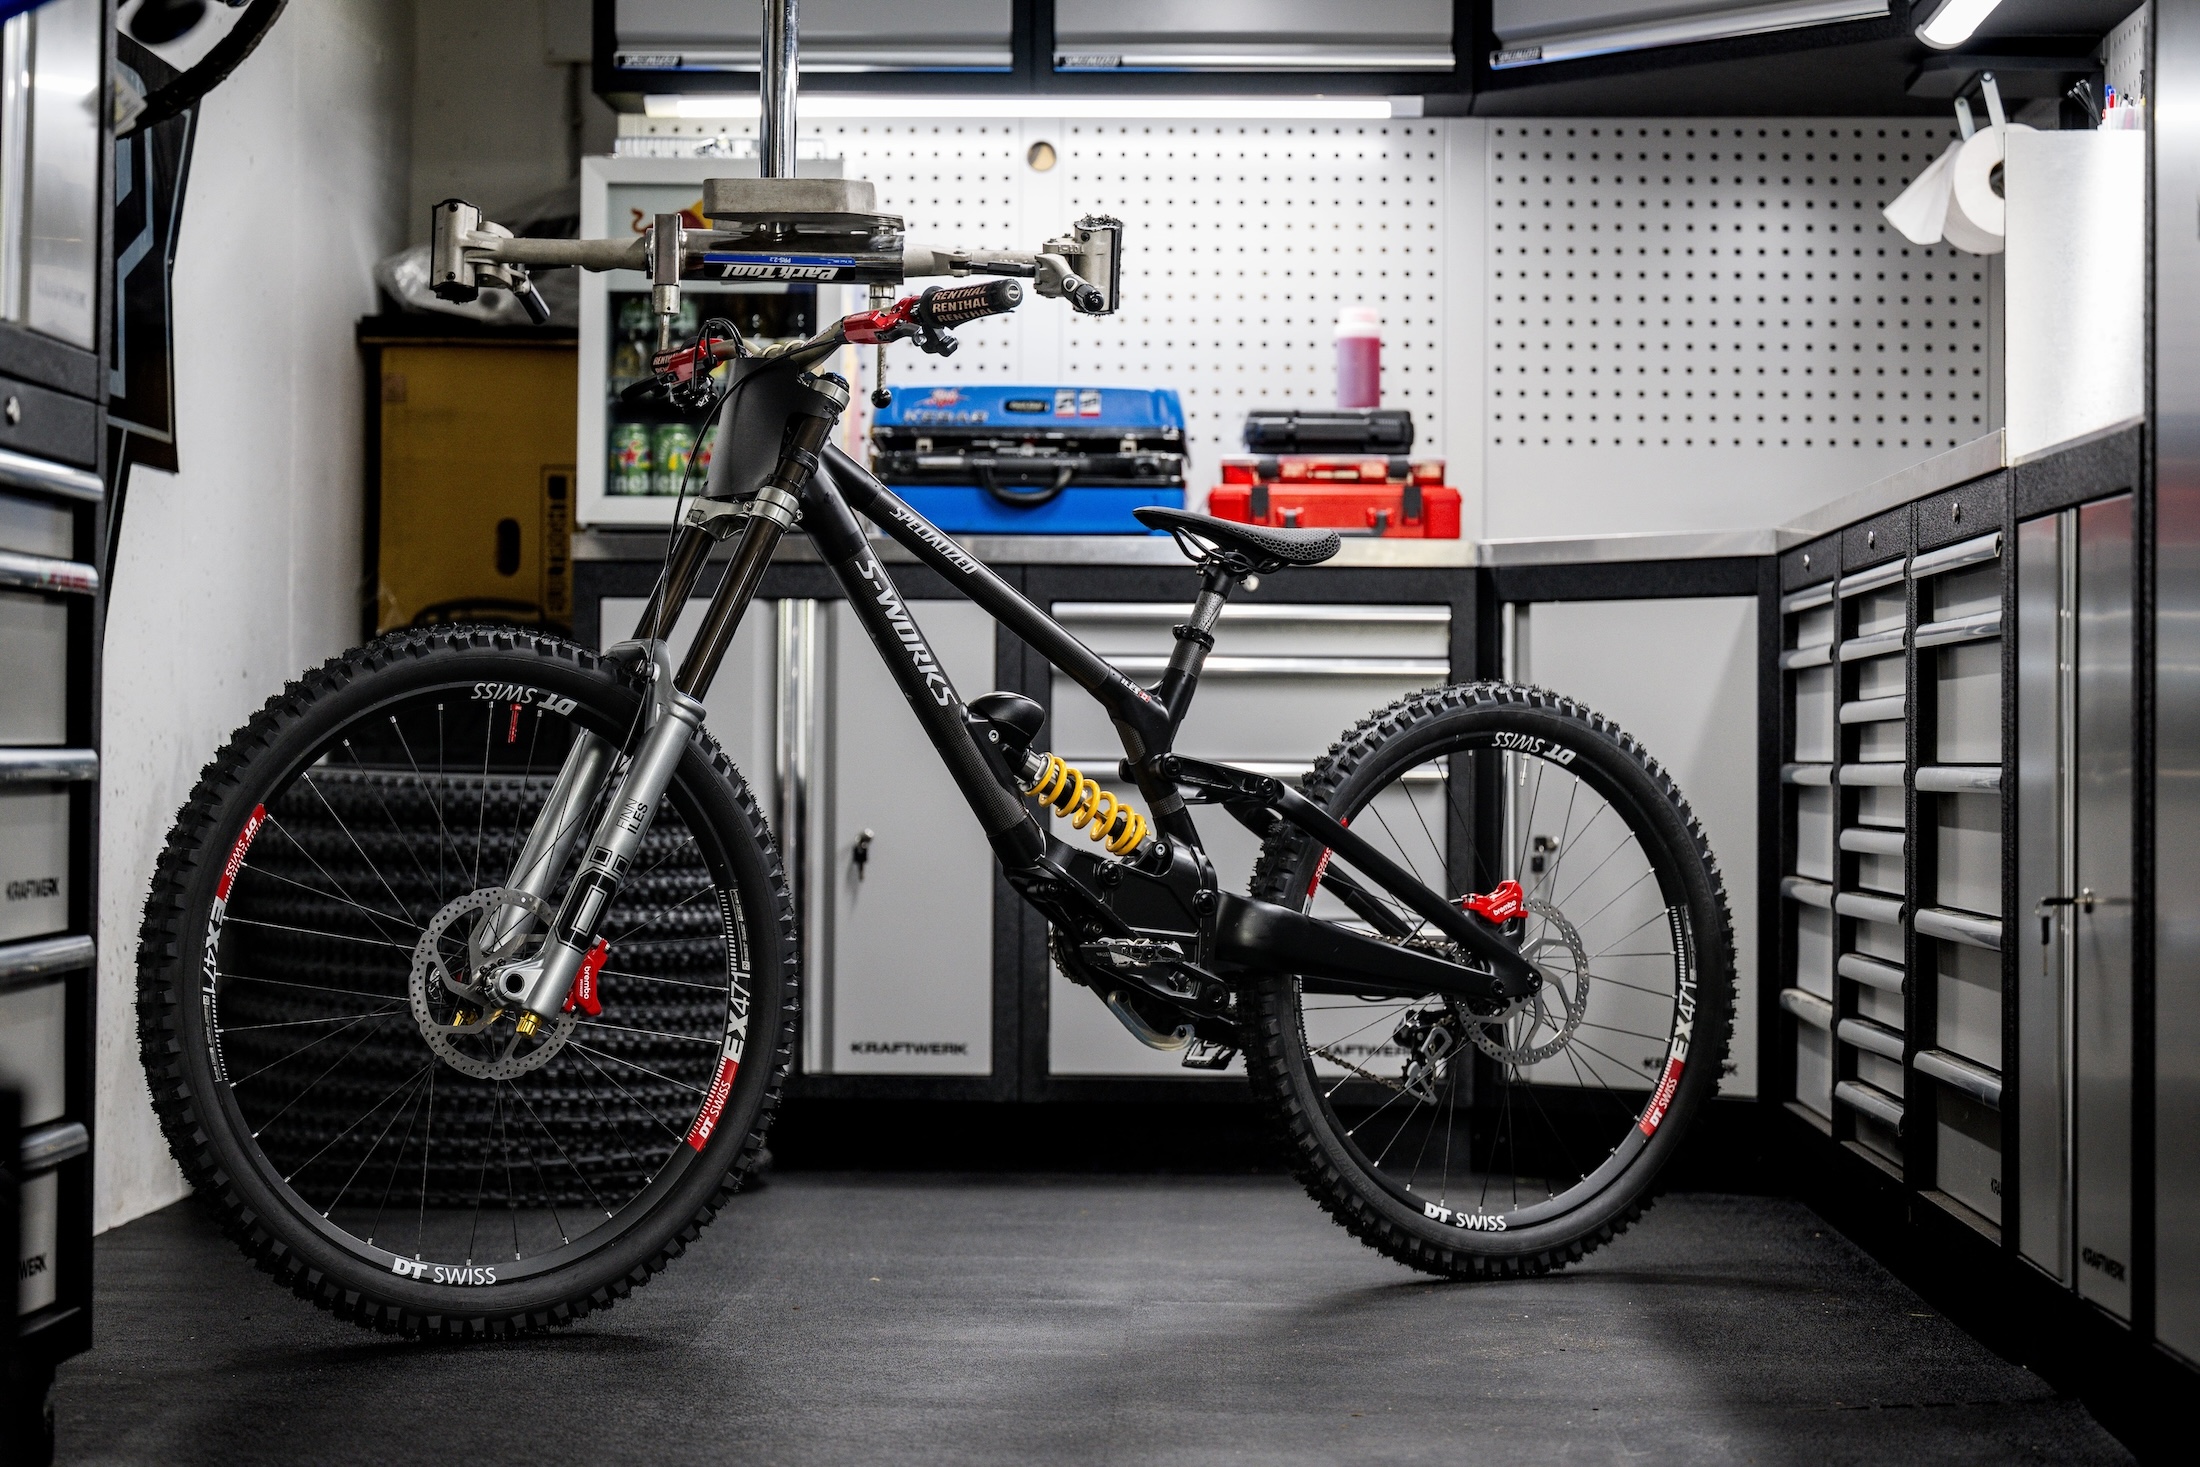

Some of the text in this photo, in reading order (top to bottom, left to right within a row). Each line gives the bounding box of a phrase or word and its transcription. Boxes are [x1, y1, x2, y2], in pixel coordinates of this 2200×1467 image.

[932, 285, 988, 301] RENTHAL
[932, 296, 989, 314] RENTHAL
[937, 307, 997, 323] RENTHAL
[889, 506, 978, 575] SPECIALIZED
[855, 559, 959, 707] S-WORKS
[470, 682, 578, 716] DT SWISS
[1491, 731, 1577, 766] DT SWISS
[244, 816, 258, 840] DT
[615, 797, 640, 830] FINN
[627, 802, 648, 835] ILES
[225, 838, 246, 878] SWISS
[1492, 900, 1517, 916] brembo
[583, 965, 592, 1000] brembo
[849, 1041, 968, 1056] KRAFTWERK
[698, 1116, 714, 1140] DT
[709, 1080, 731, 1117] SWISS
[1649, 1107, 1663, 1127] DT
[1658, 1077, 1678, 1109] SWISS
[1423, 1201, 1507, 1232] DT SWISS
[392, 1257, 497, 1286] DT SWISS
